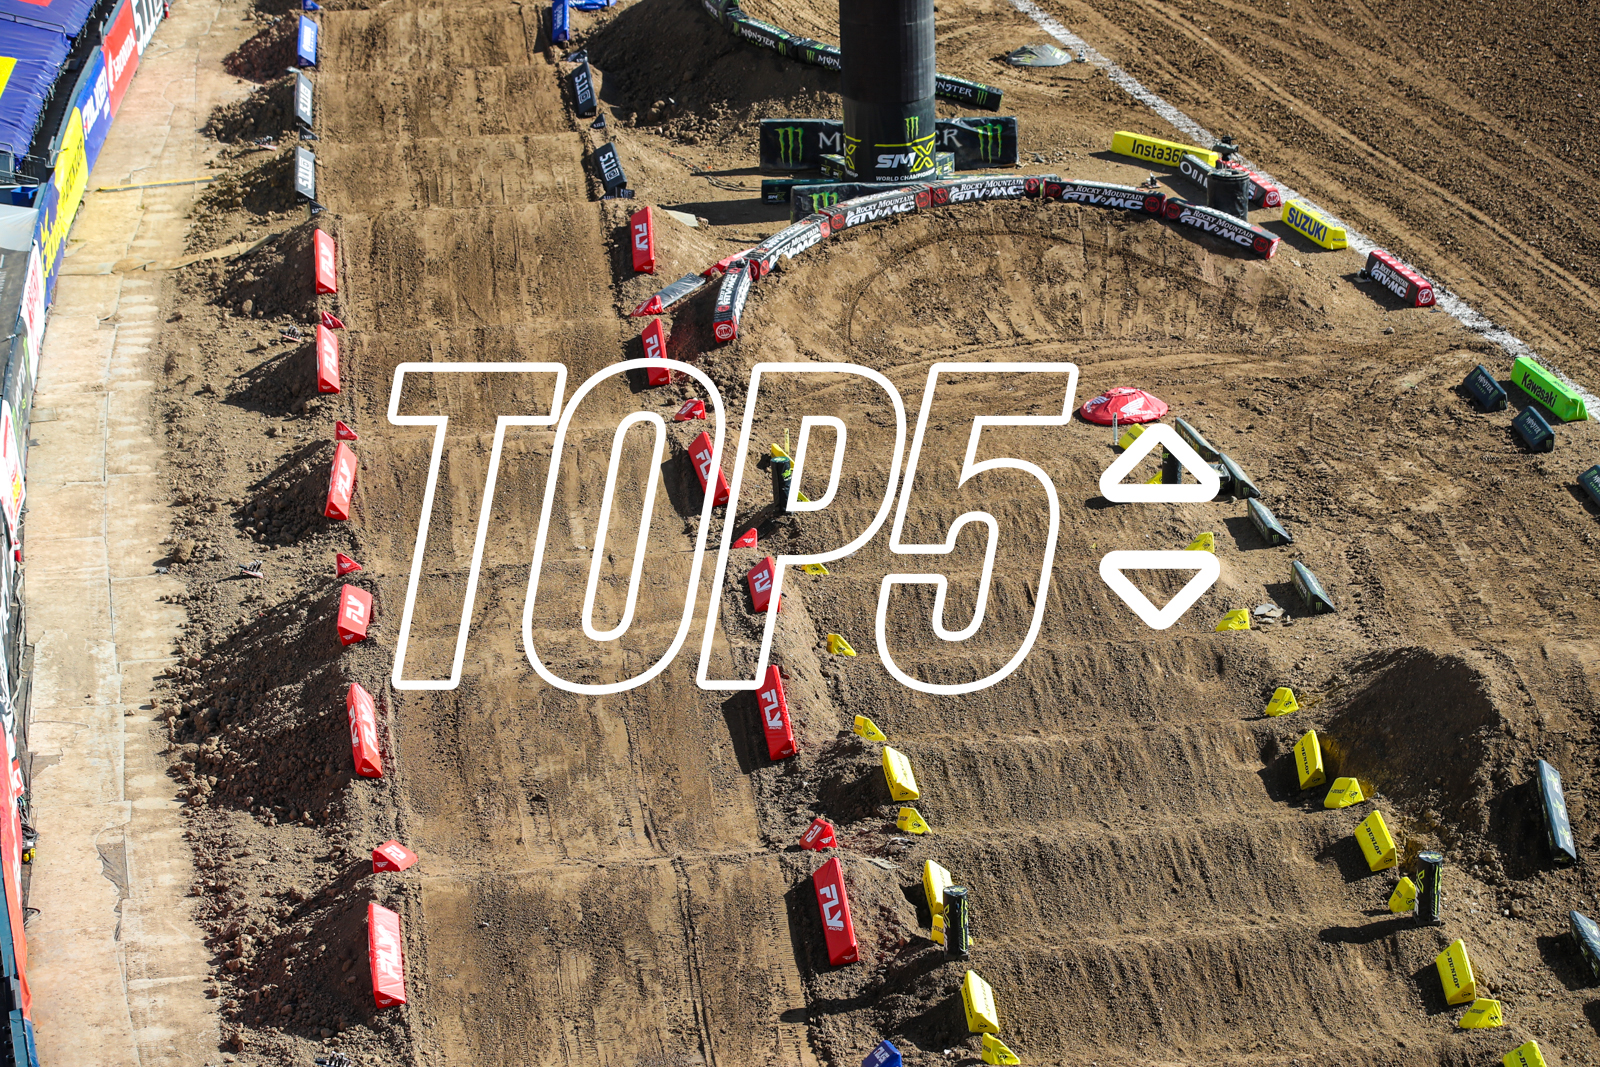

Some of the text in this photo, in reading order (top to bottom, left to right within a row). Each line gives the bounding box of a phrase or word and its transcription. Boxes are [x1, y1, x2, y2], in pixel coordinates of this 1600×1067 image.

[961, 179, 1024, 191] ROCKY MOUNTAIN
[1075, 185, 1144, 200] ROCKY MOUNTAIN
[856, 195, 914, 214] ROCKY MOUNTAIN
[635, 223, 649, 250] FLY
[1193, 210, 1255, 239] ROCKY MOUNTAIN
[1287, 206, 1328, 243] SUZUKI
[320, 242, 334, 278] FLY
[323, 338, 337, 376] FLY
[1521, 371, 1557, 408] Kawasaki
[752, 569, 772, 593] FLY
[345, 594, 365, 625] FLY
[761, 688, 783, 727] FLY
[1366, 827, 1382, 855] DUNLOP
[819, 884, 844, 928] FLY
[1448, 957, 1460, 988] DUNLOP
